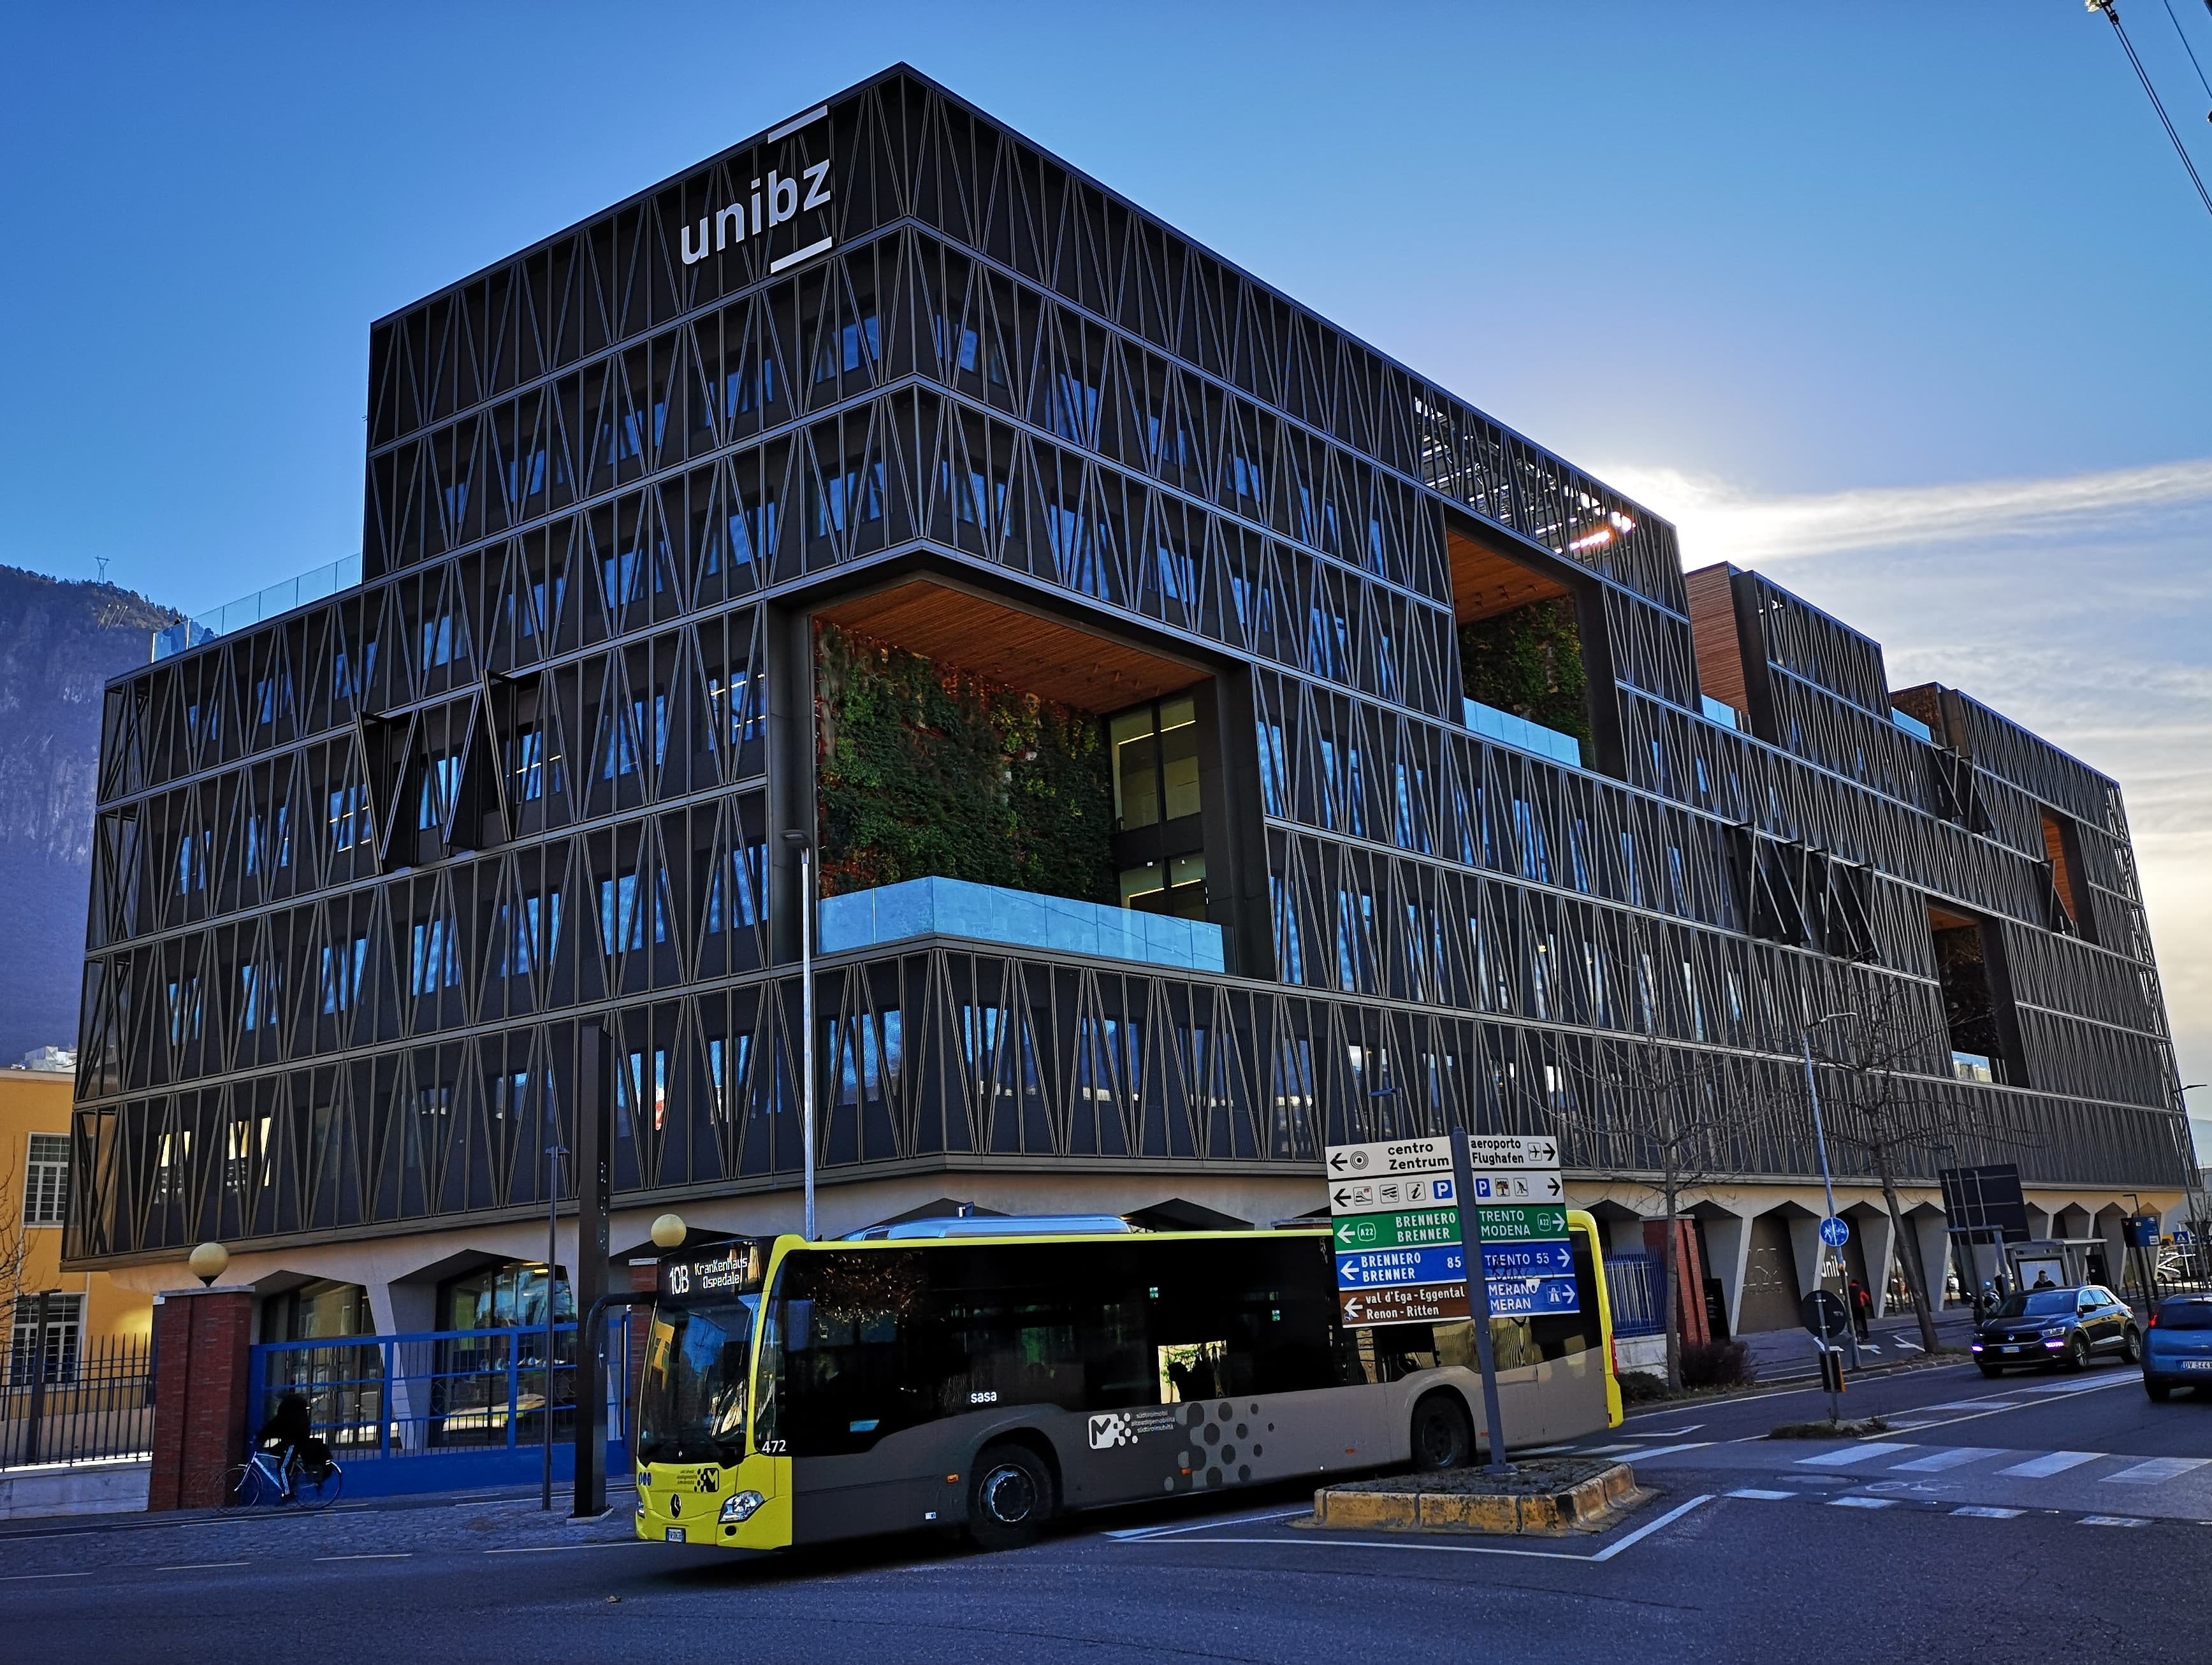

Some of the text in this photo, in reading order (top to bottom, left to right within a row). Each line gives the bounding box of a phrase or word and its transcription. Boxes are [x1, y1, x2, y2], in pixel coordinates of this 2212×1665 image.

[681, 159, 831, 265] unibz
[1388, 1142, 1434, 1156] centro
[1471, 1138, 1521, 1151] aeroporto
[1389, 1157, 1449, 1170] Zentrum
[1472, 1152, 1524, 1166] Flughafen
[1395, 1212, 1456, 1228] BRENNERO
[1479, 1210, 1524, 1222] TRENTO
[1360, 1228, 1374, 1237] A22
[1397, 1227, 1450, 1242] BRENNER
[1481, 1225, 1531, 1237] MODENA
[1361, 1252, 1462, 1269] BRENNERO 85
[1484, 1253, 1530, 1266] TRENTO
[1822, 1254, 1848, 1277] uni
[669, 1264, 689, 1295] 10B
[702, 1272, 739, 1289] Ospedale
[1362, 1267, 1416, 1283] BRENNER
[1365, 1291, 1381, 1304] val
[1385, 1290, 1413, 1304] d'Ega
[1420, 1286, 1466, 1302] Eggental
[1488, 1283, 1538, 1297] MERANO
[1490, 1297, 1531, 1311] MERAN
[1366, 1308, 1398, 1320] Renon
[1407, 1306, 1439, 1317] Ritten
[970, 1392, 997, 1404] sasa
[761, 1439, 786, 1453] 472
